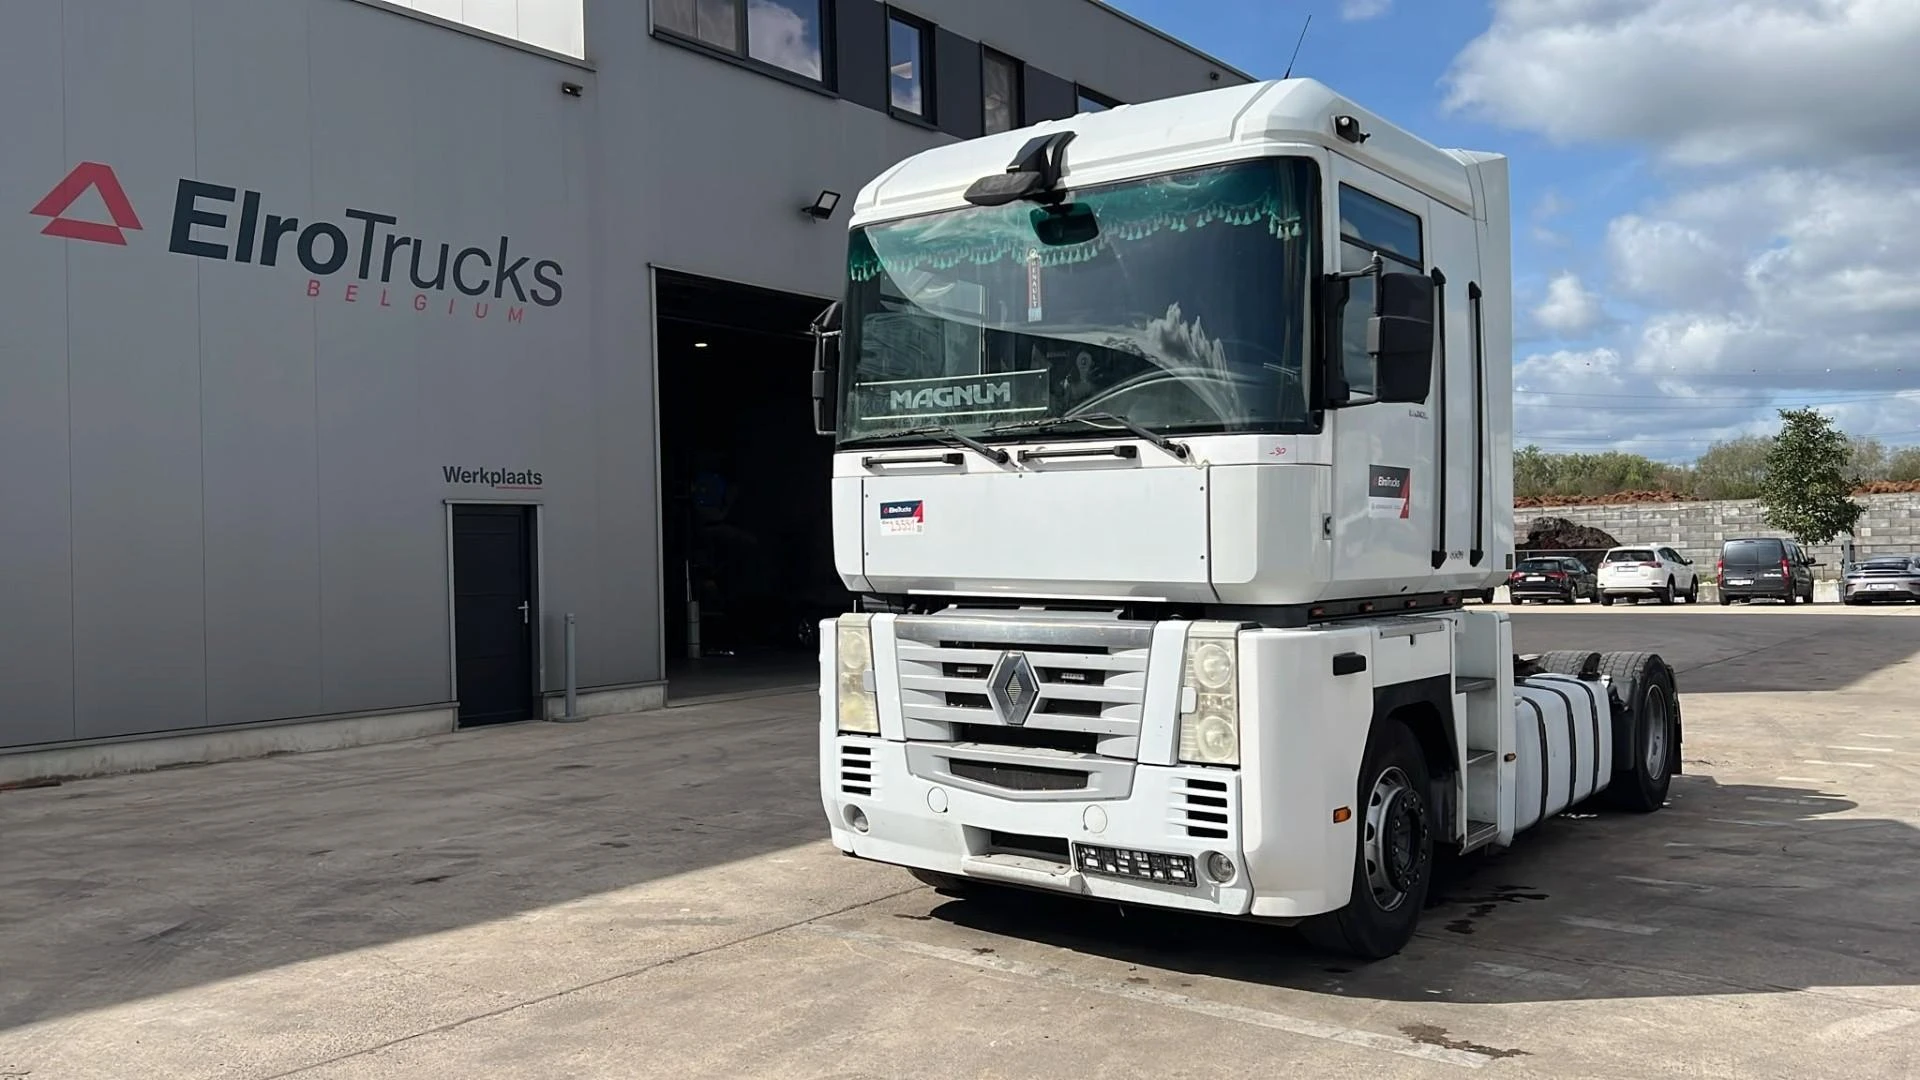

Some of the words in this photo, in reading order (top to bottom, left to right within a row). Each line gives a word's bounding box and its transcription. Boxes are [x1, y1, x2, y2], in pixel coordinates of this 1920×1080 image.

[169, 178, 563, 306] ElroTrucks
[307, 279, 523, 324] BELGIUM
[890, 382, 1011, 410] MAGNUM
[443, 465, 543, 487] Werkplaats
